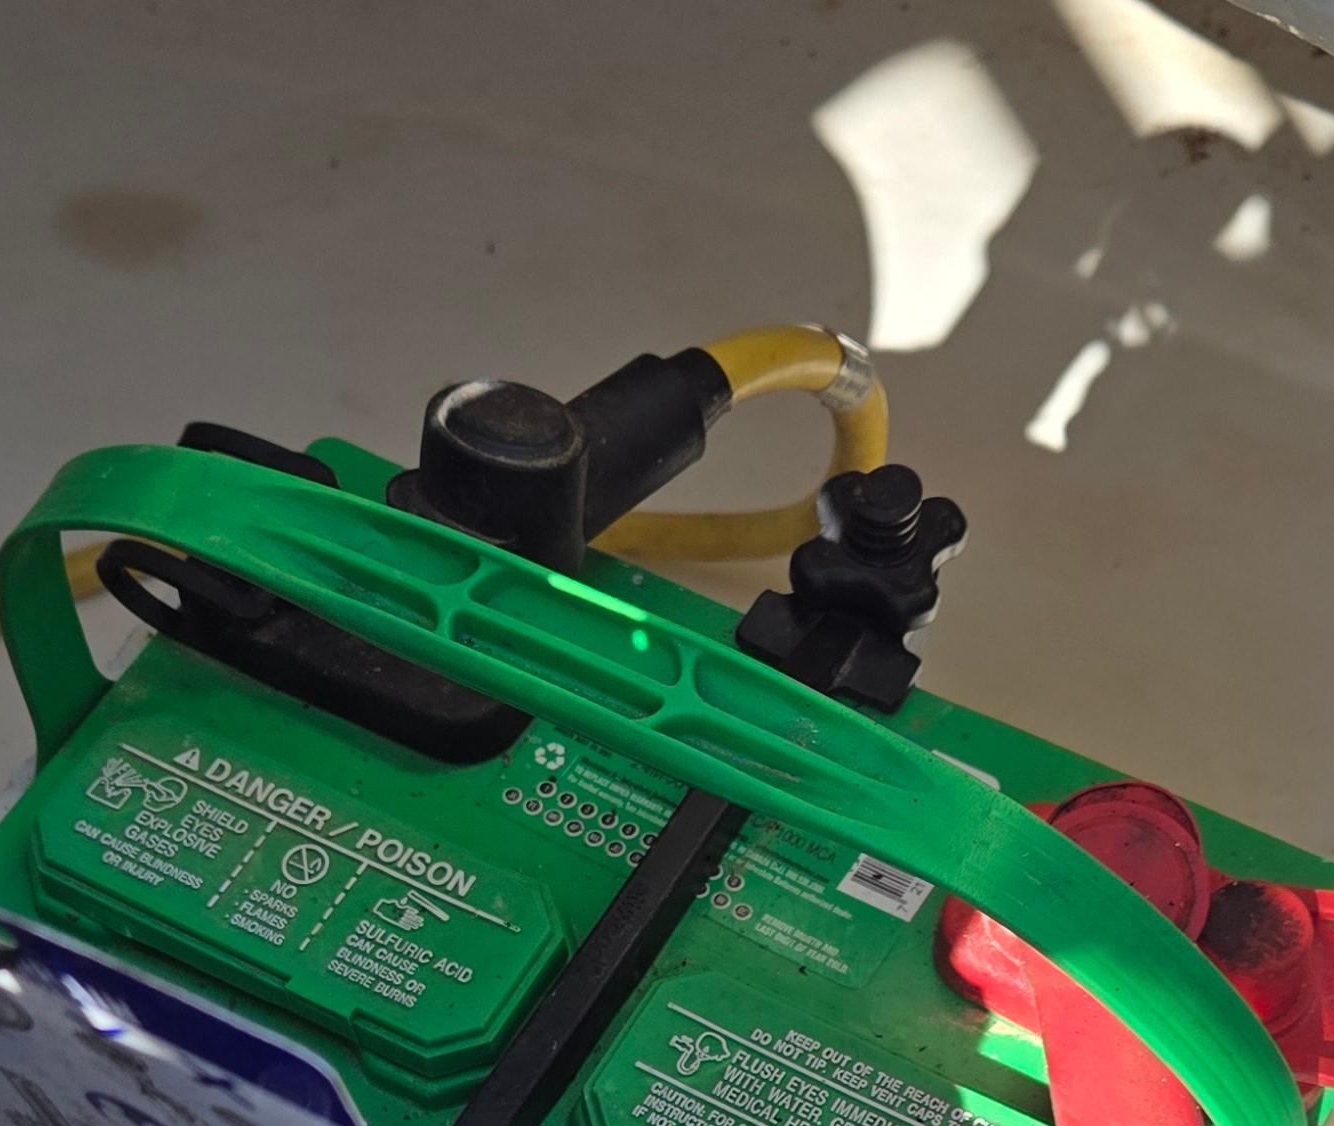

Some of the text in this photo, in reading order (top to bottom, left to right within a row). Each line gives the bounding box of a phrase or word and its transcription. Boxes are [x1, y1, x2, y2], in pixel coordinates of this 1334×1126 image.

[135, 810, 221, 858] EXPLOSIVE
[181, 814, 223, 845] EYES
[193, 800, 248, 833] SHIELD
[205, 759, 331, 830] DANGER
[356, 829, 476, 896] POISON
[75, 821, 203, 888] CAN CAUSE BLINDNESS
[125, 825, 178, 856] GASES
[103, 851, 164, 885] OR INJURY
[250, 890, 298, 917] SPARKS
[270, 880, 297, 898] NO
[231, 914, 285, 945] SMOKING
[240, 902, 287, 929] FLAMES
[337, 947, 425, 994] BLINDNESS OR
[346, 935, 418, 974] CAN CAUSE
[356, 920, 472, 982] SULFURIC ACID
[328, 960, 416, 1007] SEVERE BURNS
[724, 1065, 765, 1093] WITH
[768, 1087, 822, 1125] WATER.
[732, 1050, 786, 1084] FLUSH
[786, 1077, 829, 1105] EYES
[751, 1029, 772, 1045] DO
[773, 1040, 803, 1059] NOT
[805, 1054, 827, 1073] TIP.
[833, 1068, 868, 1089] KEEP
[871, 1085, 906, 1107] VENT
[907, 1103, 943, 1126] CAPS
[786, 1030, 820, 1051] KEEP
[822, 1048, 851, 1067] OUT
[853, 1062, 874, 1076] OF
[876, 1073, 903, 1092] THE
[904, 1086, 949, 1114] REACH
[952, 1109, 976, 1122] OF
[632, 1105, 648, 1117] IF
[651, 1082, 705, 1117] CAUTION:
[713, 1081, 779, 1124] MEDICAL
